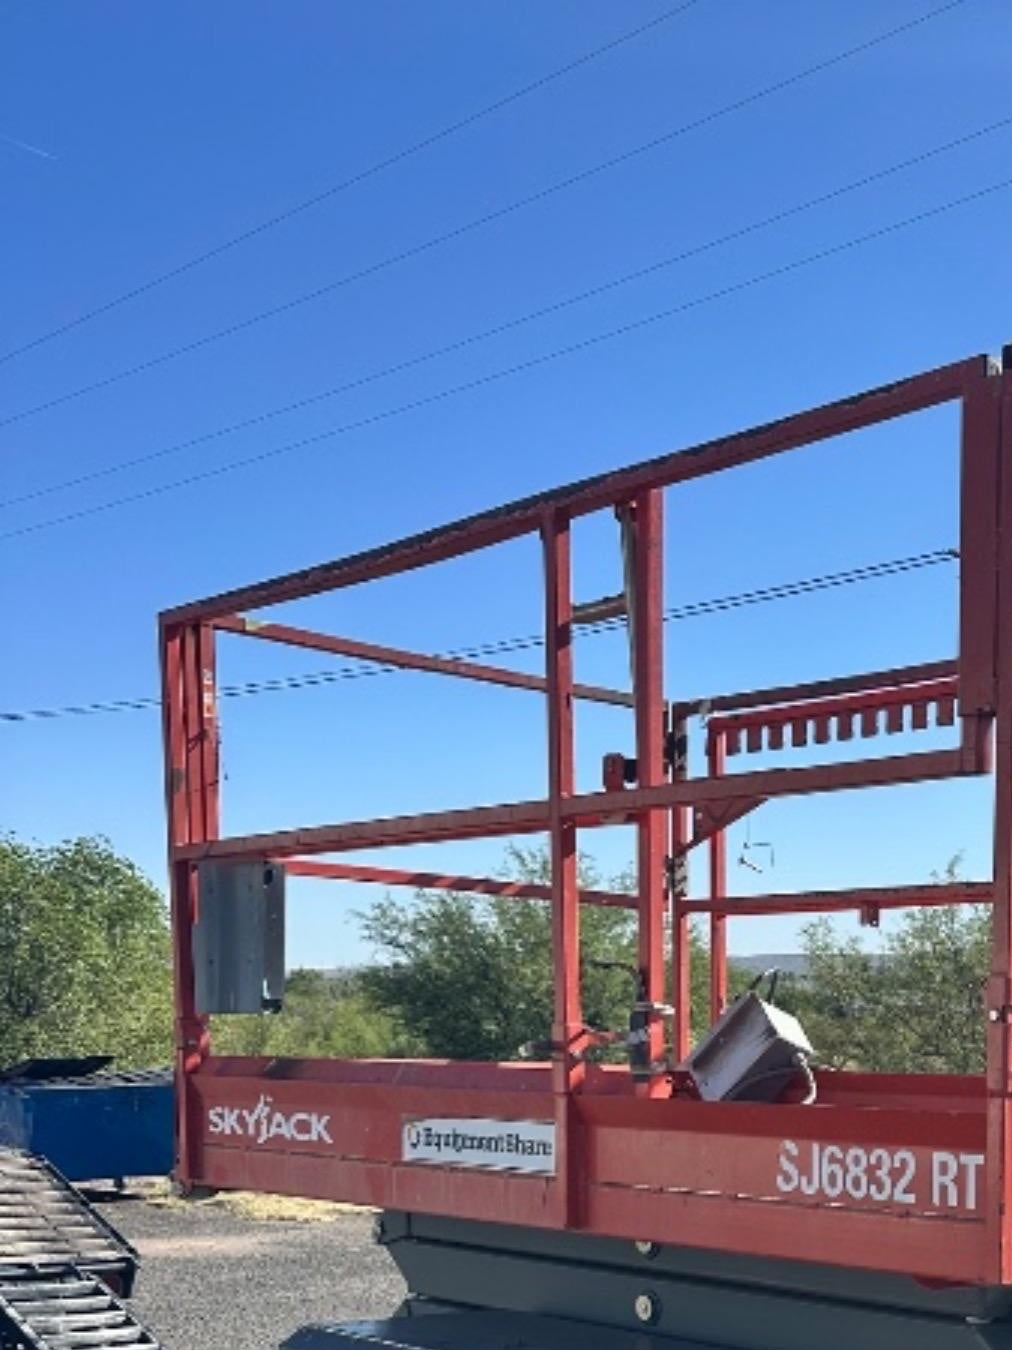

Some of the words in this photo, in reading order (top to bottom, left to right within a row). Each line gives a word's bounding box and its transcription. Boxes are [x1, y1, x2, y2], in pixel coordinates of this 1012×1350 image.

[208, 1094, 334, 1144] SKYJACK
[776, 1139, 916, 1204] SJ6832
[931, 1151, 985, 1210] RT
